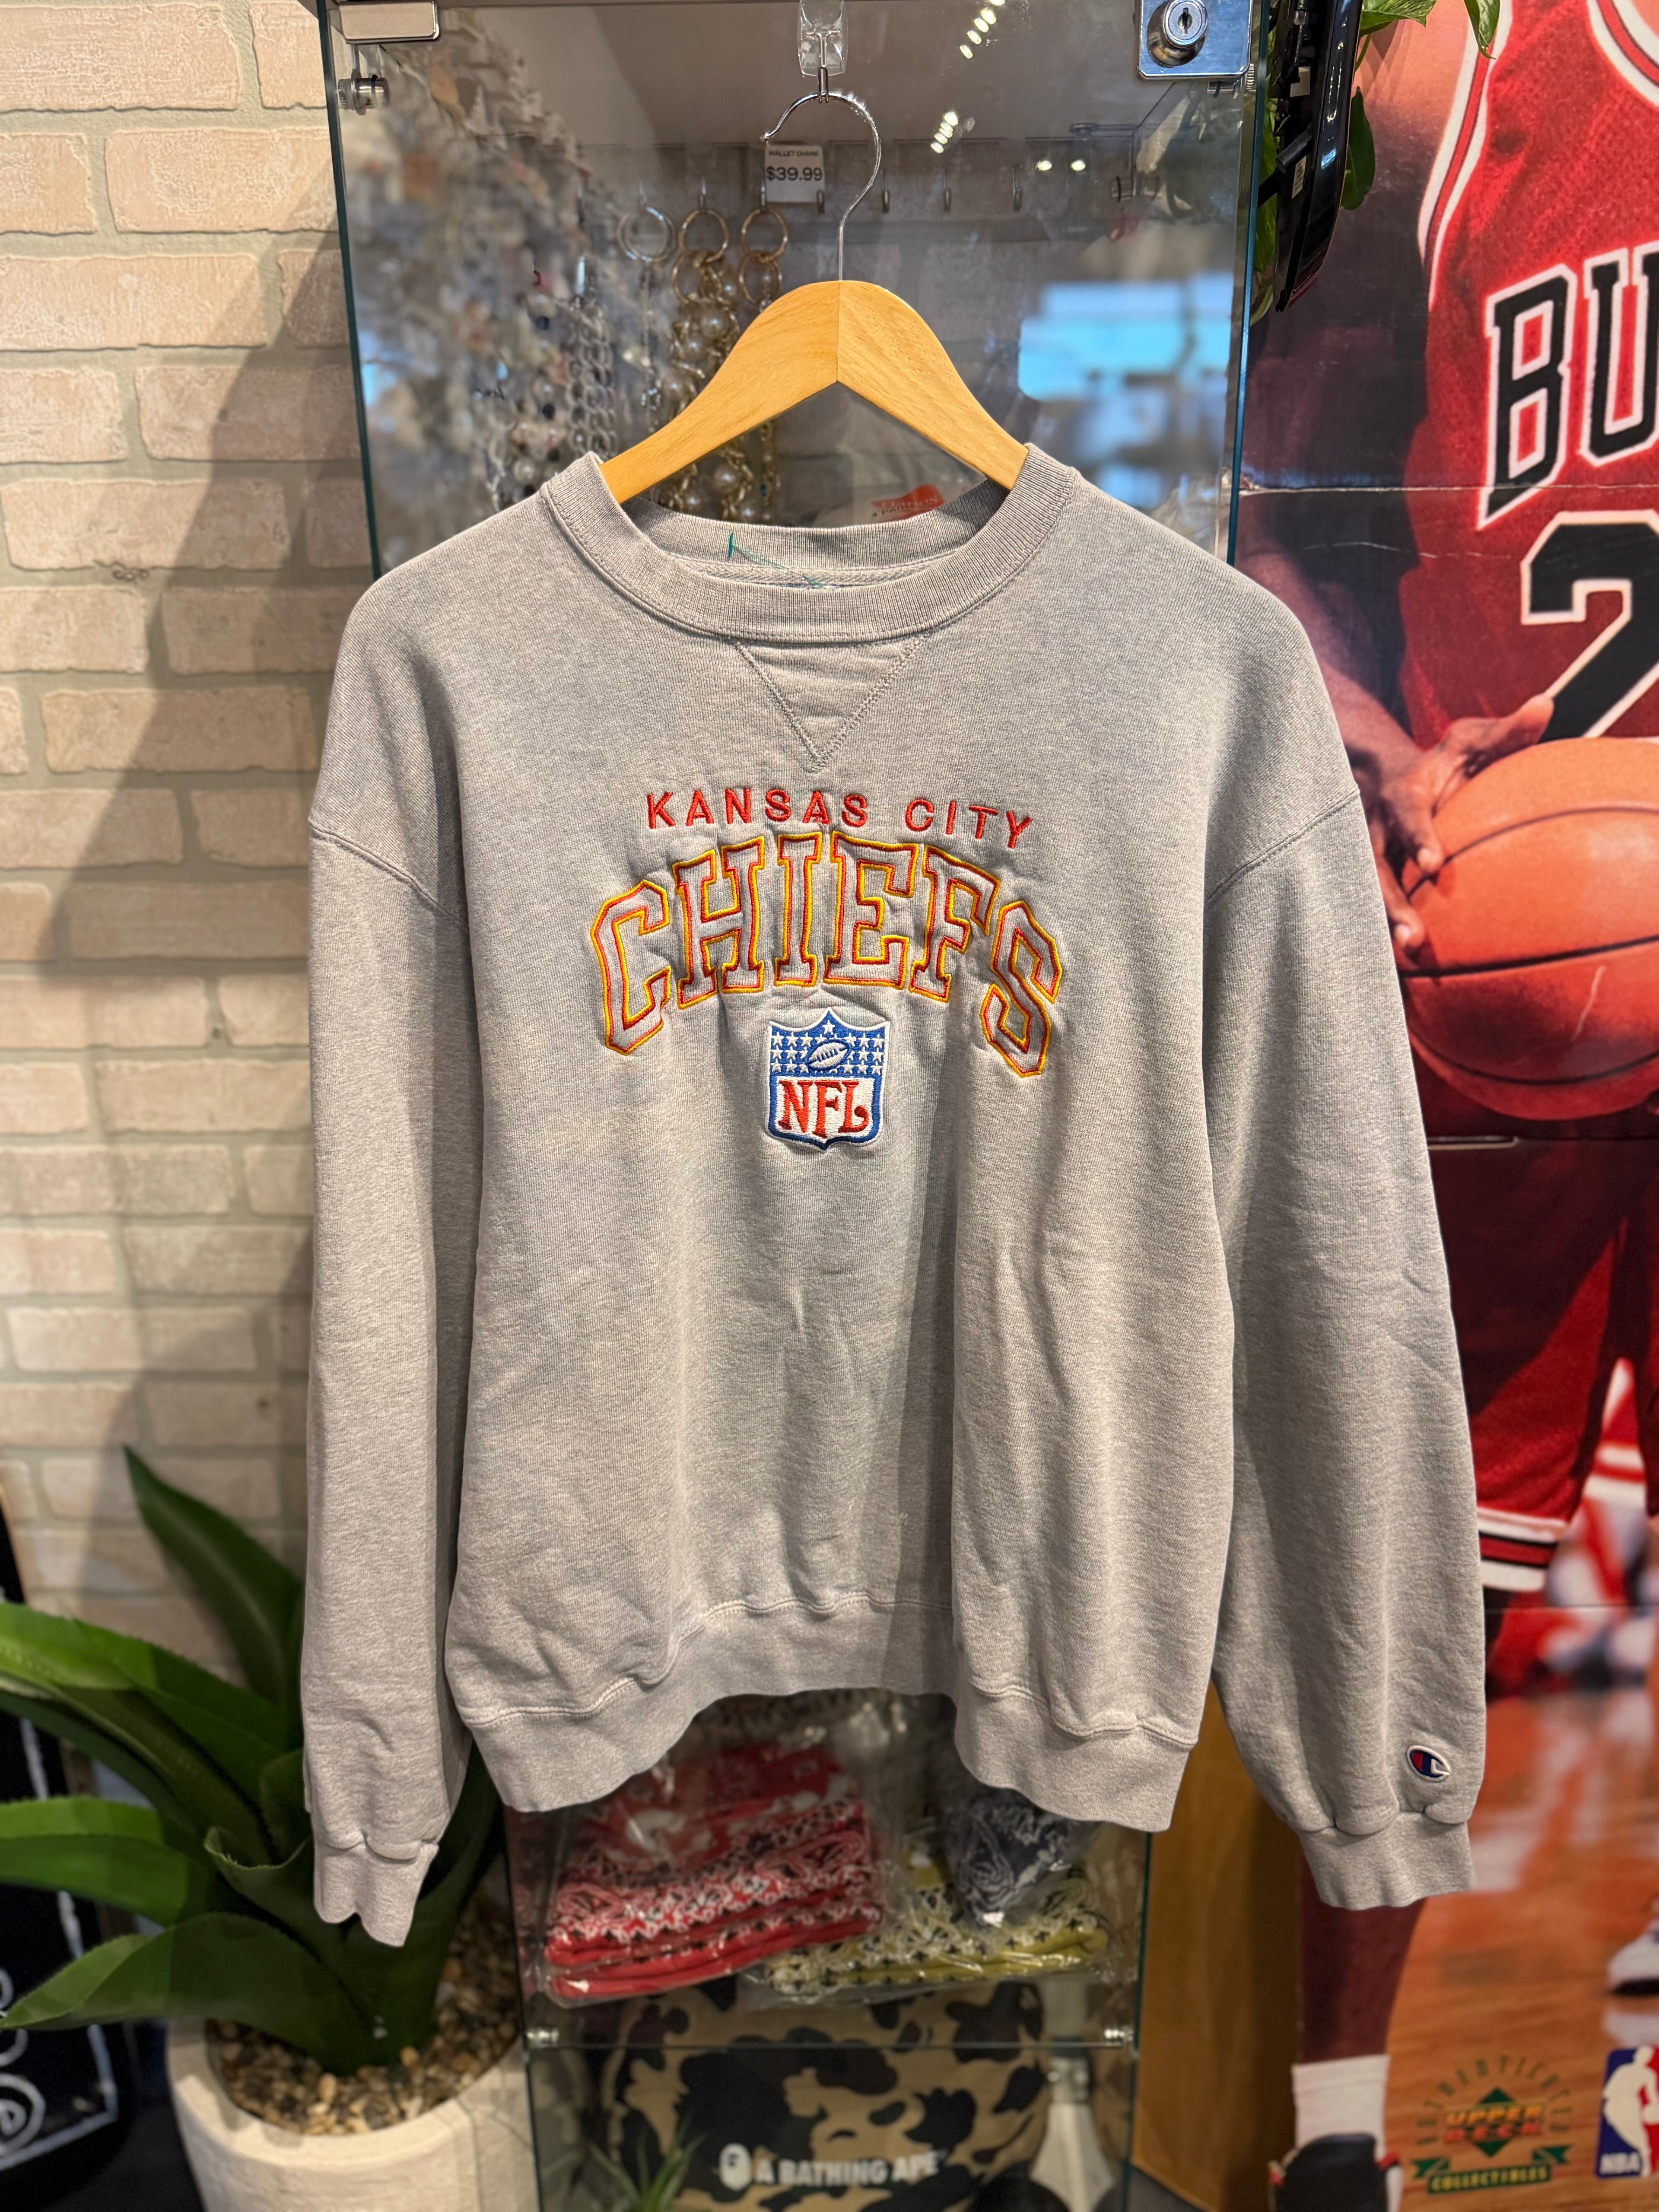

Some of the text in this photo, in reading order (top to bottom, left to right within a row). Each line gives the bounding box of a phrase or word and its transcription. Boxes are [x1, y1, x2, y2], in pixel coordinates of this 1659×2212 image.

[767, 166, 823, 181] $39.99
[647, 788, 1033, 849] KANSAS CITY
[590, 831, 1063, 1078] CHIEFS
[778, 1080, 871, 1138] NFL
[1447, 2105, 1543, 2126] UPPER
[1444, 2120, 1541, 2143] DECK
[756, 2150, 940, 2186] A BATHING APE
[1599, 2152, 1640, 2175] NBA
[1430, 2165, 1548, 2192] COLLECTIBLES
